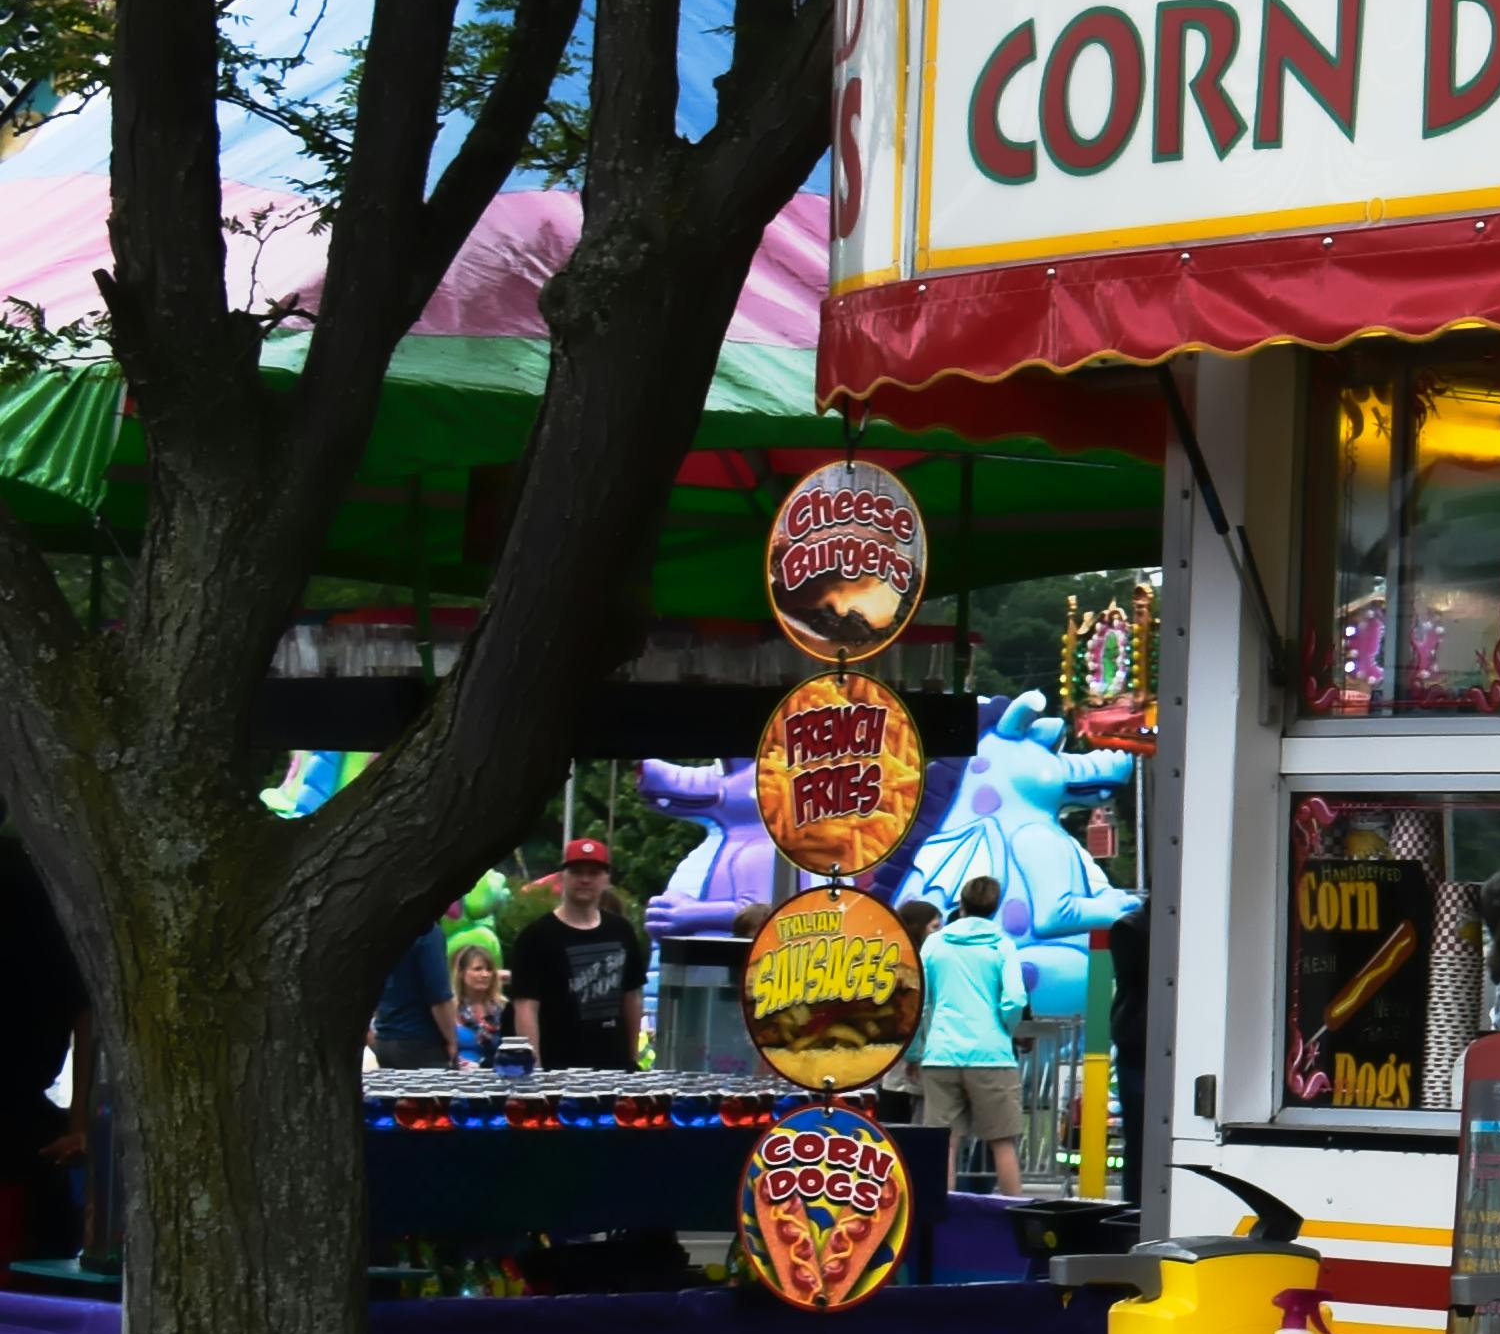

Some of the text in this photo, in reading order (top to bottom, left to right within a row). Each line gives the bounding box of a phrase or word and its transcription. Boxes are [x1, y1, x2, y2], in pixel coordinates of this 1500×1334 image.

[785, 487, 916, 543] Cheese
[781, 535, 913, 593] Burgers
[784, 703, 889, 771] FRENCH
[792, 761, 884, 829] FRIES
[776, 910, 843, 942] ITALIAN
[1300, 871, 1379, 931] Corn
[752, 935, 900, 1020] SAUSAGES
[1332, 1052, 1412, 1109] Dogs
[761, 1130, 895, 1182] CORN
[765, 1165, 882, 1212] DOGS
